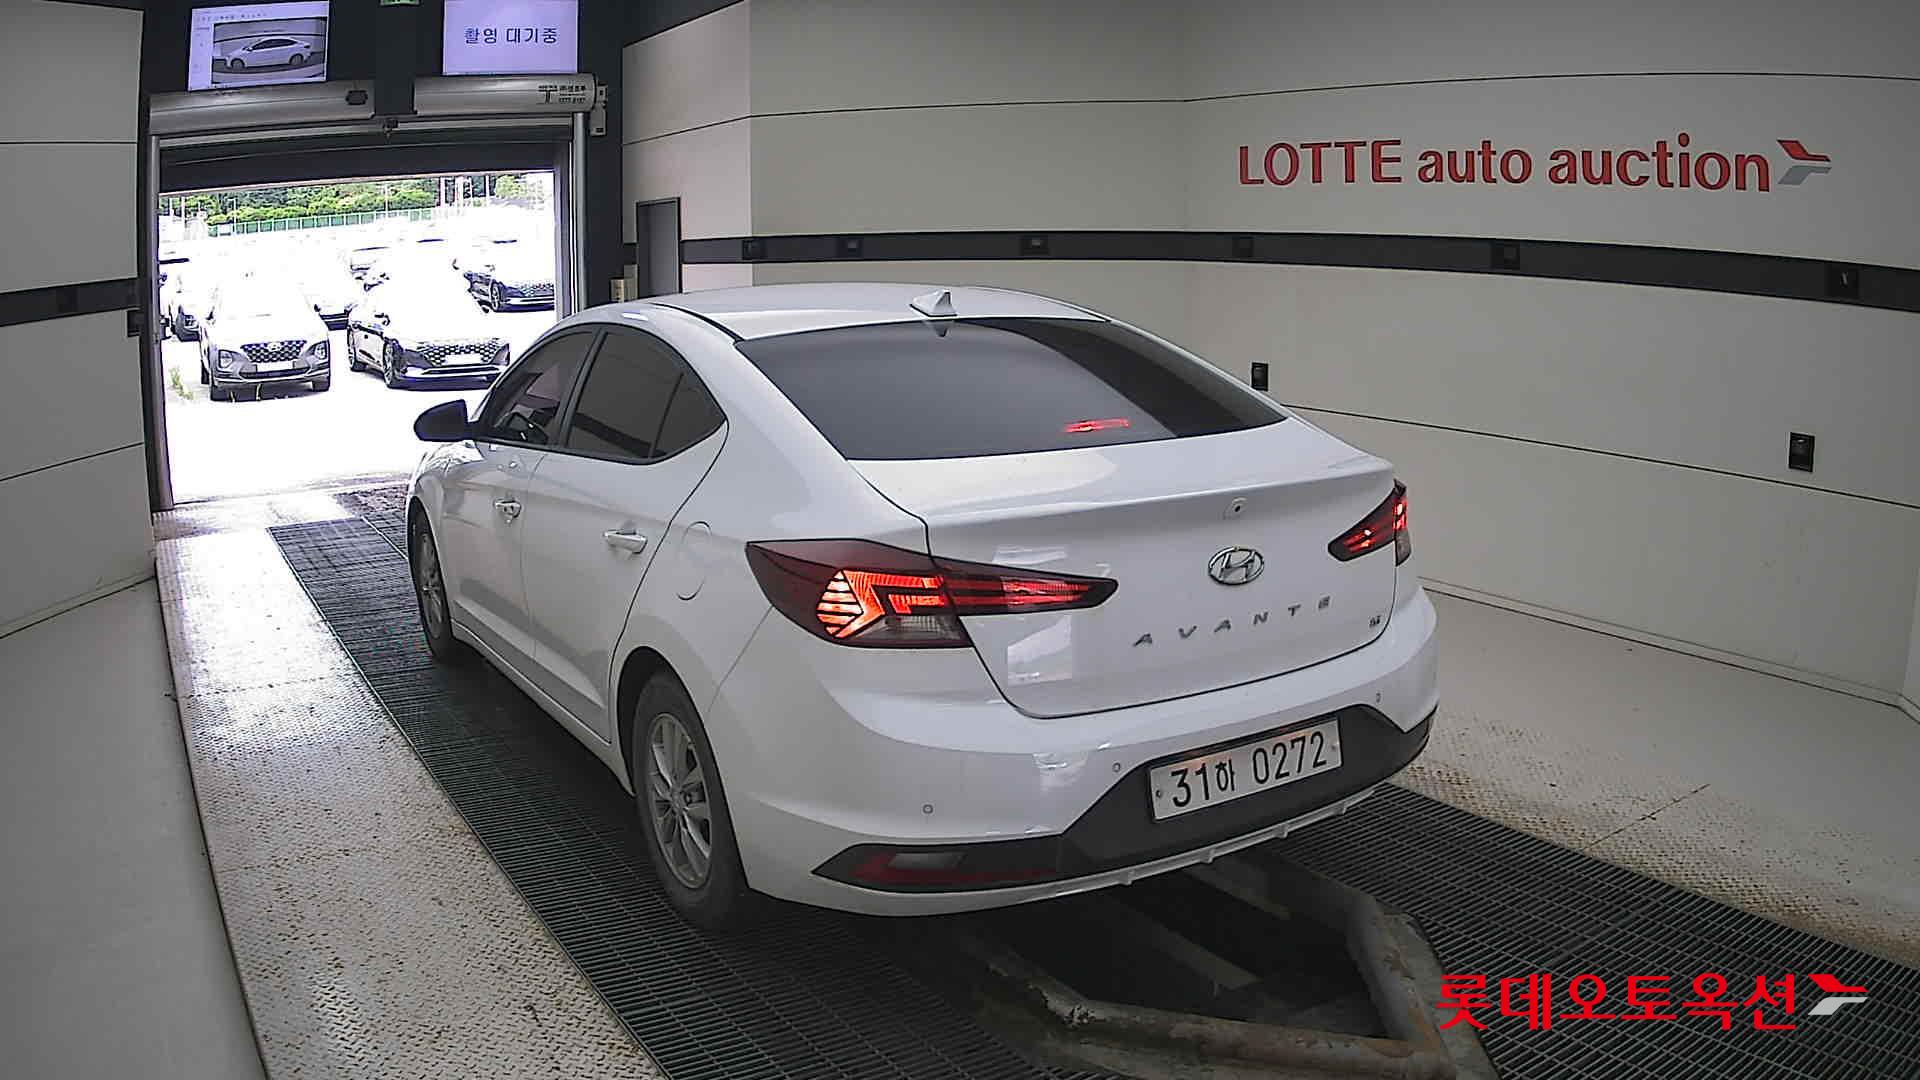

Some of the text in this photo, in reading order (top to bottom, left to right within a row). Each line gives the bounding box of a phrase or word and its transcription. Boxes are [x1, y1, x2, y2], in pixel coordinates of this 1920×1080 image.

[506, 27, 558, 45] 대기중
[1239, 132, 1771, 192] LOTTE auto auction
[1132, 595, 1332, 647] AVANTE
[1170, 731, 1327, 808] 31하 0272
